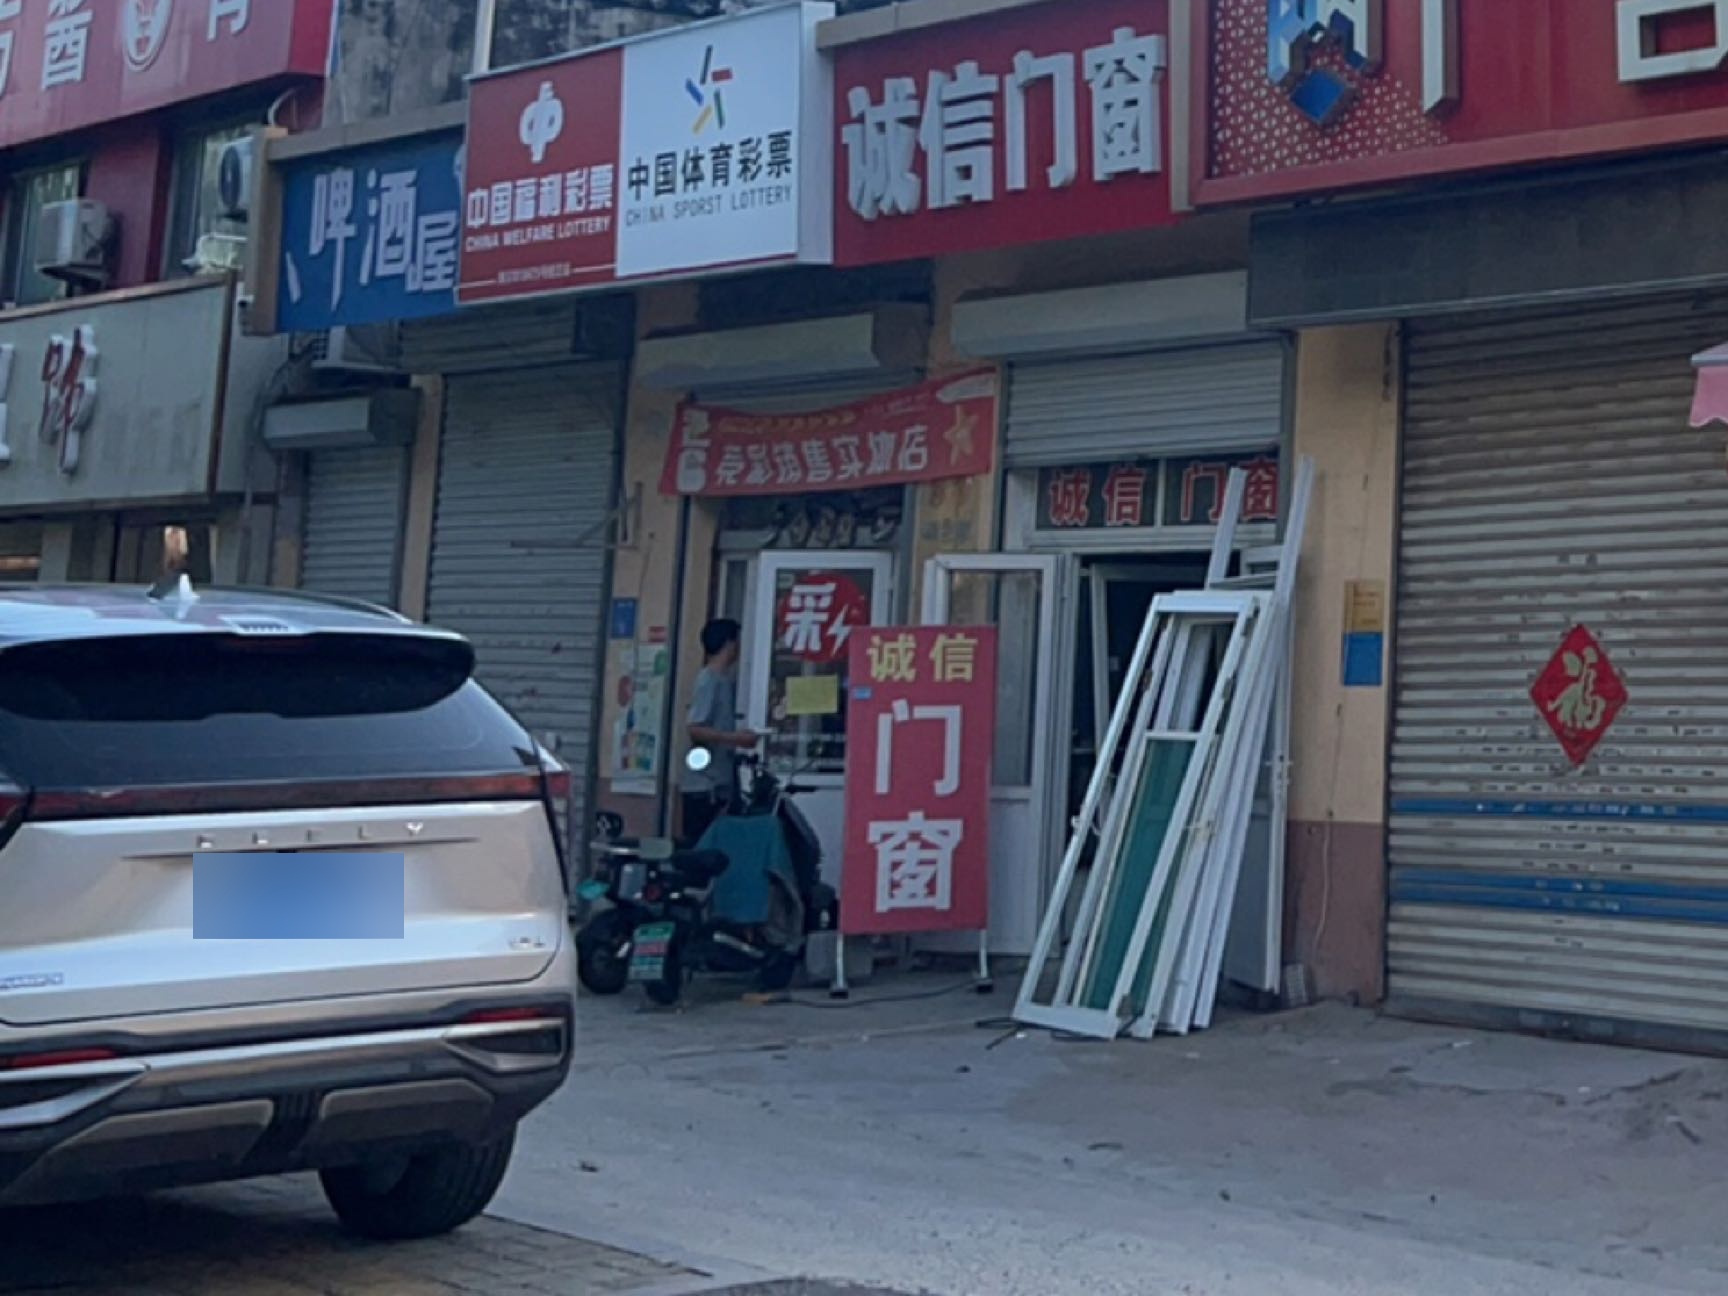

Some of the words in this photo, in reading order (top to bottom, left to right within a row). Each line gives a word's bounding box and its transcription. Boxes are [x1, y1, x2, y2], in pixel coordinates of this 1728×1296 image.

[842, 26, 1167, 221] 诚信门窗
[467, 164, 614, 229] 中国福利彩票
[628, 129, 793, 201] 中国体育彩票
[309, 167, 457, 312] 啤酒屋
[466, 232, 499, 252] CHINA
[503, 223, 555, 245] WELFARE
[558, 216, 612, 238] LOTTERY
[626, 206, 664, 226] CHINA
[732, 185, 792, 210] LOTTERY
[1049, 457, 1279, 526] 诚信门窗
[867, 633, 978, 682] 诚信
[866, 699, 963, 913] 门窗
